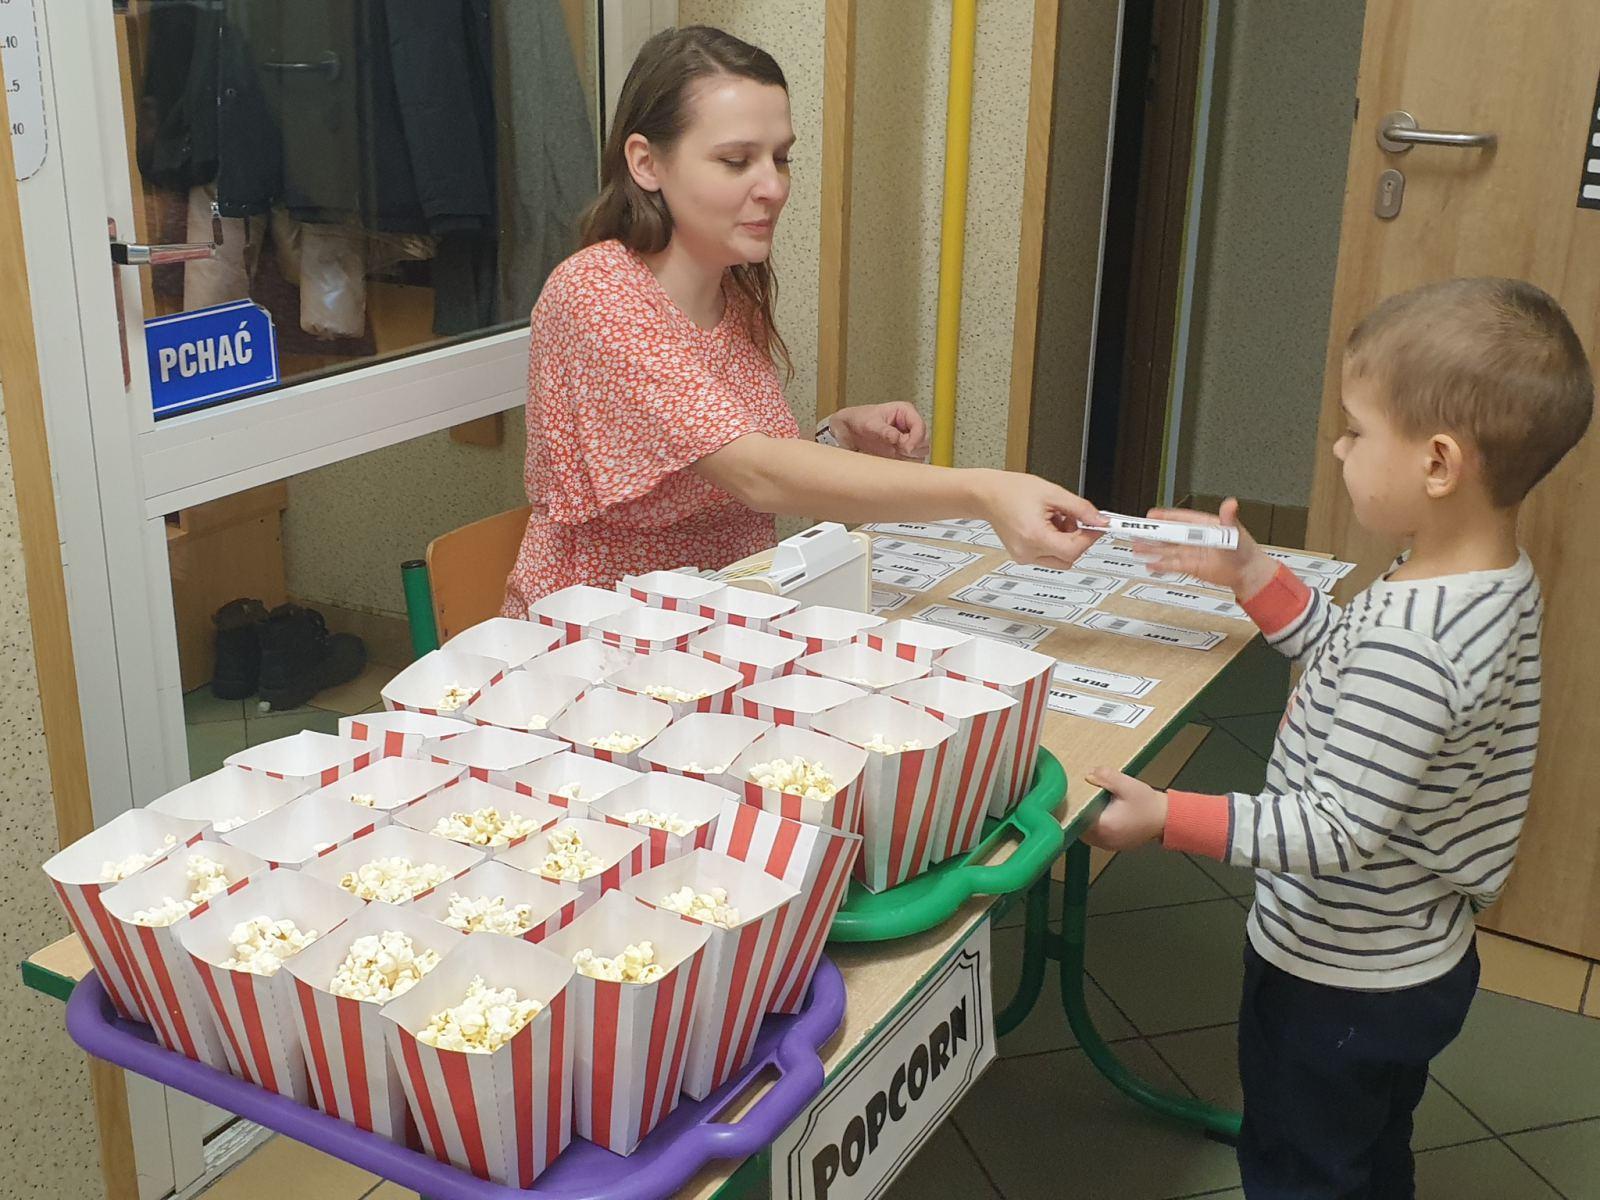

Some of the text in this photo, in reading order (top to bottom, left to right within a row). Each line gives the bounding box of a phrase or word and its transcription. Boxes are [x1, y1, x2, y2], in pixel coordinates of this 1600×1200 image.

[159, 321, 252, 382] PCHAĆ
[1121, 521, 1160, 531] BILET
[812, 994, 967, 1200] POPCORN
